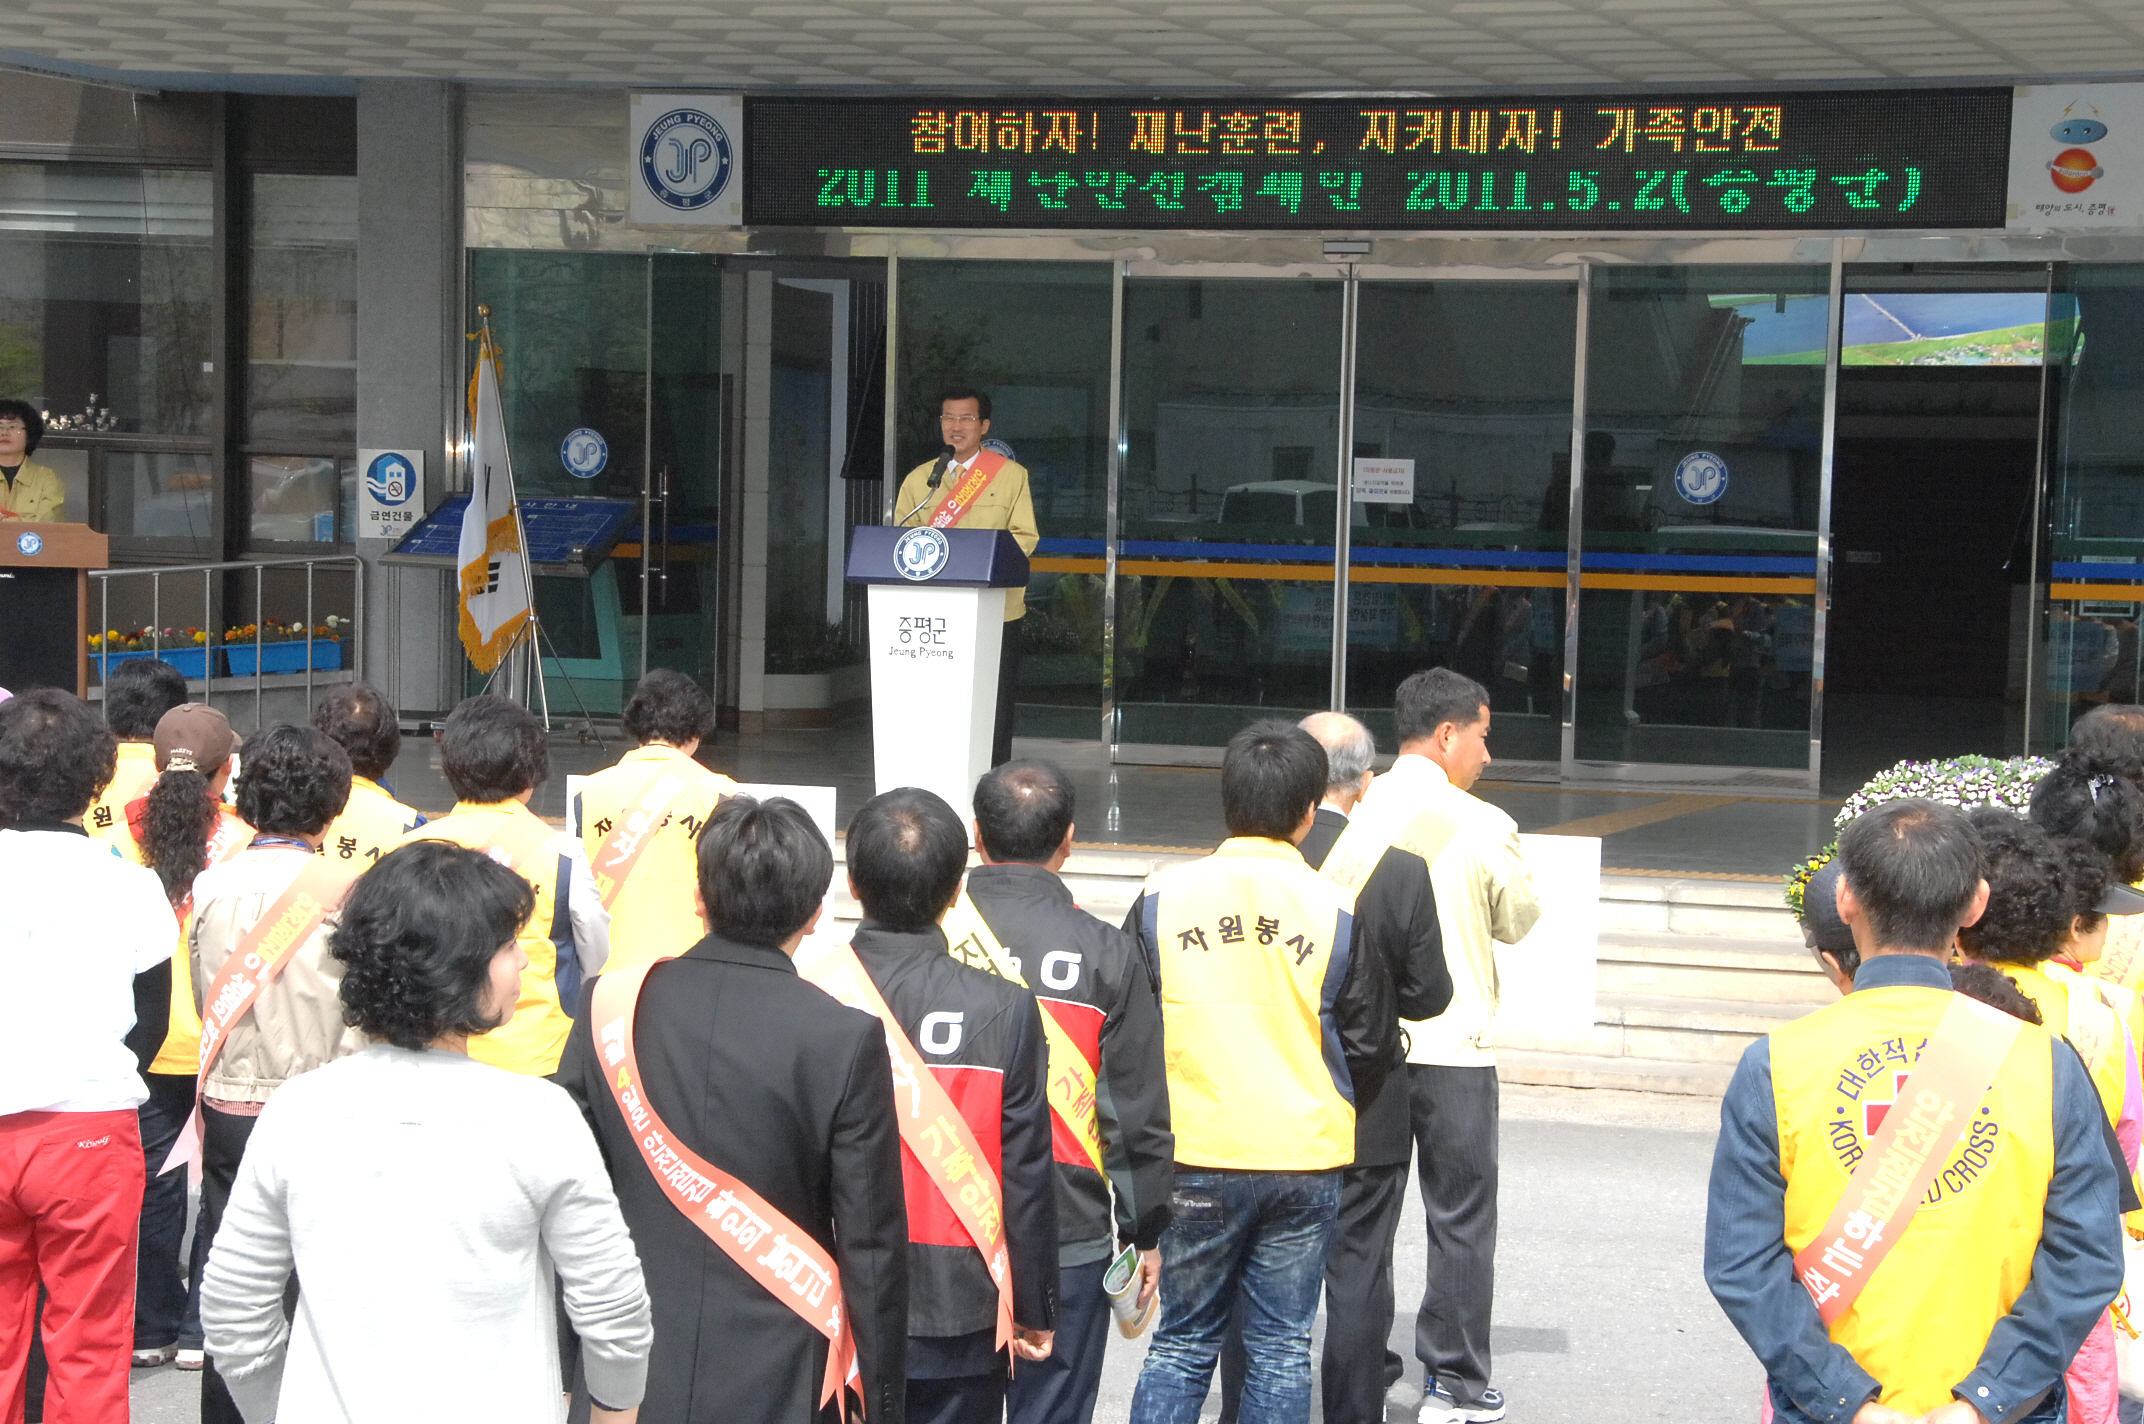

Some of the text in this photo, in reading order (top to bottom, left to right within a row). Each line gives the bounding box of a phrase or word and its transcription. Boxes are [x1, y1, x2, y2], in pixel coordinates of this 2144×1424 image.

[653, 114, 723, 142] JEUNG PYEONG
[911, 110, 1097, 153] 참여하자!
[1359, 108, 1562, 153] 지켜내자!
[1597, 106, 1782, 151] 가족안전
[817, 169, 935, 207] 2011
[369, 510, 414, 522] 금연건물
[888, 646, 954, 660] Jeung Pyeong
[898, 616, 947, 645] 증평군
[243, 891, 325, 981] 안전점검이
[1176, 914, 1315, 967] 자원봉사
[918, 1115, 1003, 1247] 가족안전
[1942, 1120, 1999, 1194] CROSS
[615, 1065, 654, 1132] 4일은
[644, 1127, 717, 1204] 안전점검
[704, 1188, 773, 1256] 확인의
[756, 1231, 834, 1306] 날입니다
[1820, 1088, 1958, 1279] 안전점검하는
